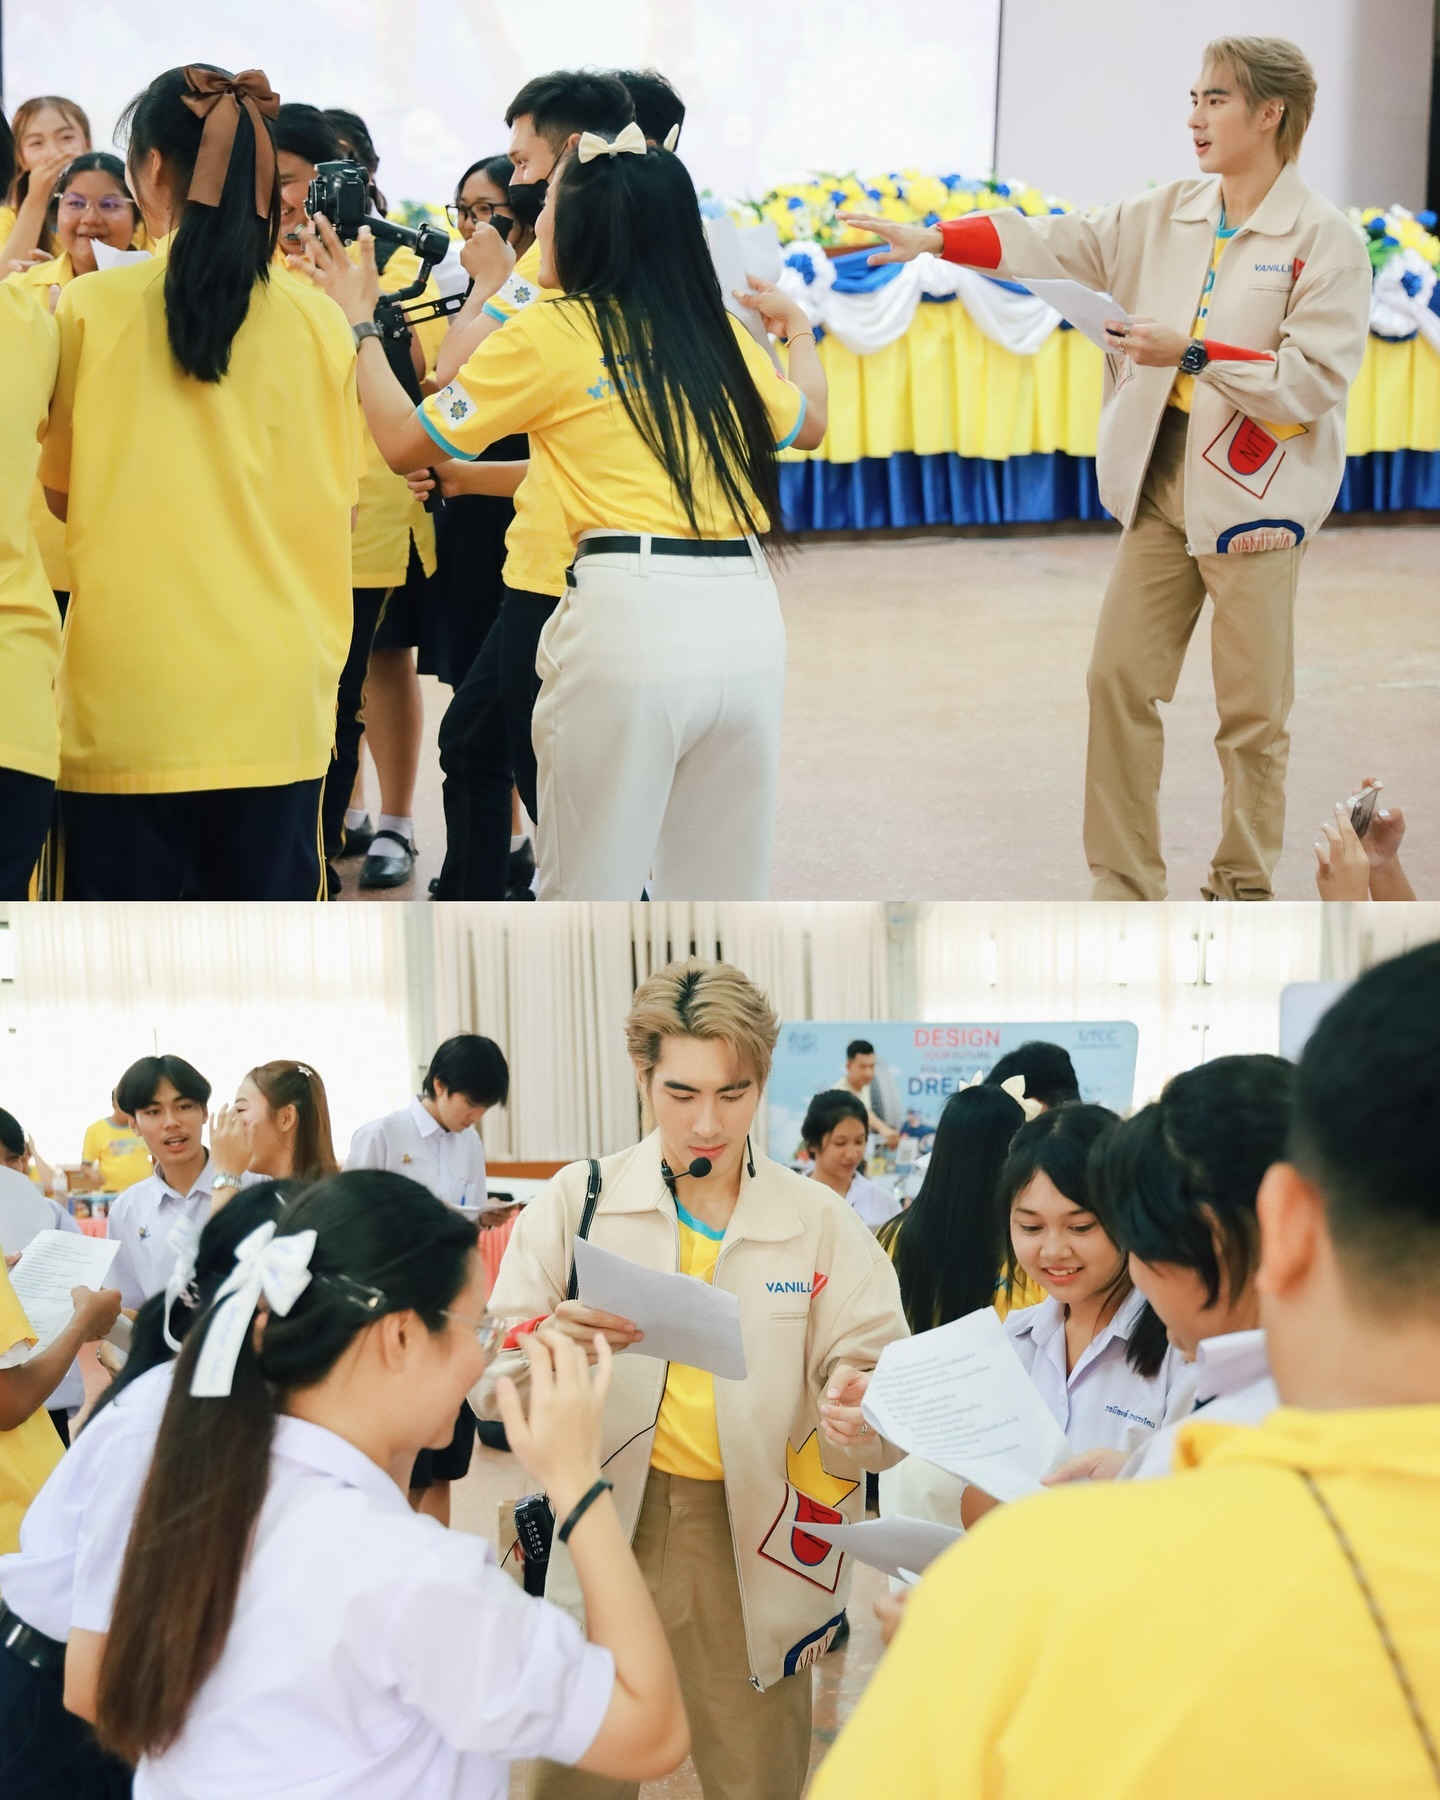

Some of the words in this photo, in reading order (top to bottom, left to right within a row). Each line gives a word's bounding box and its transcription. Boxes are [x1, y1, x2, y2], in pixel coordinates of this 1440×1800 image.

[913, 1027, 1000, 1048] DESIGN
[908, 1076, 966, 1096] DRE
[765, 1281, 813, 1293] VANILL
